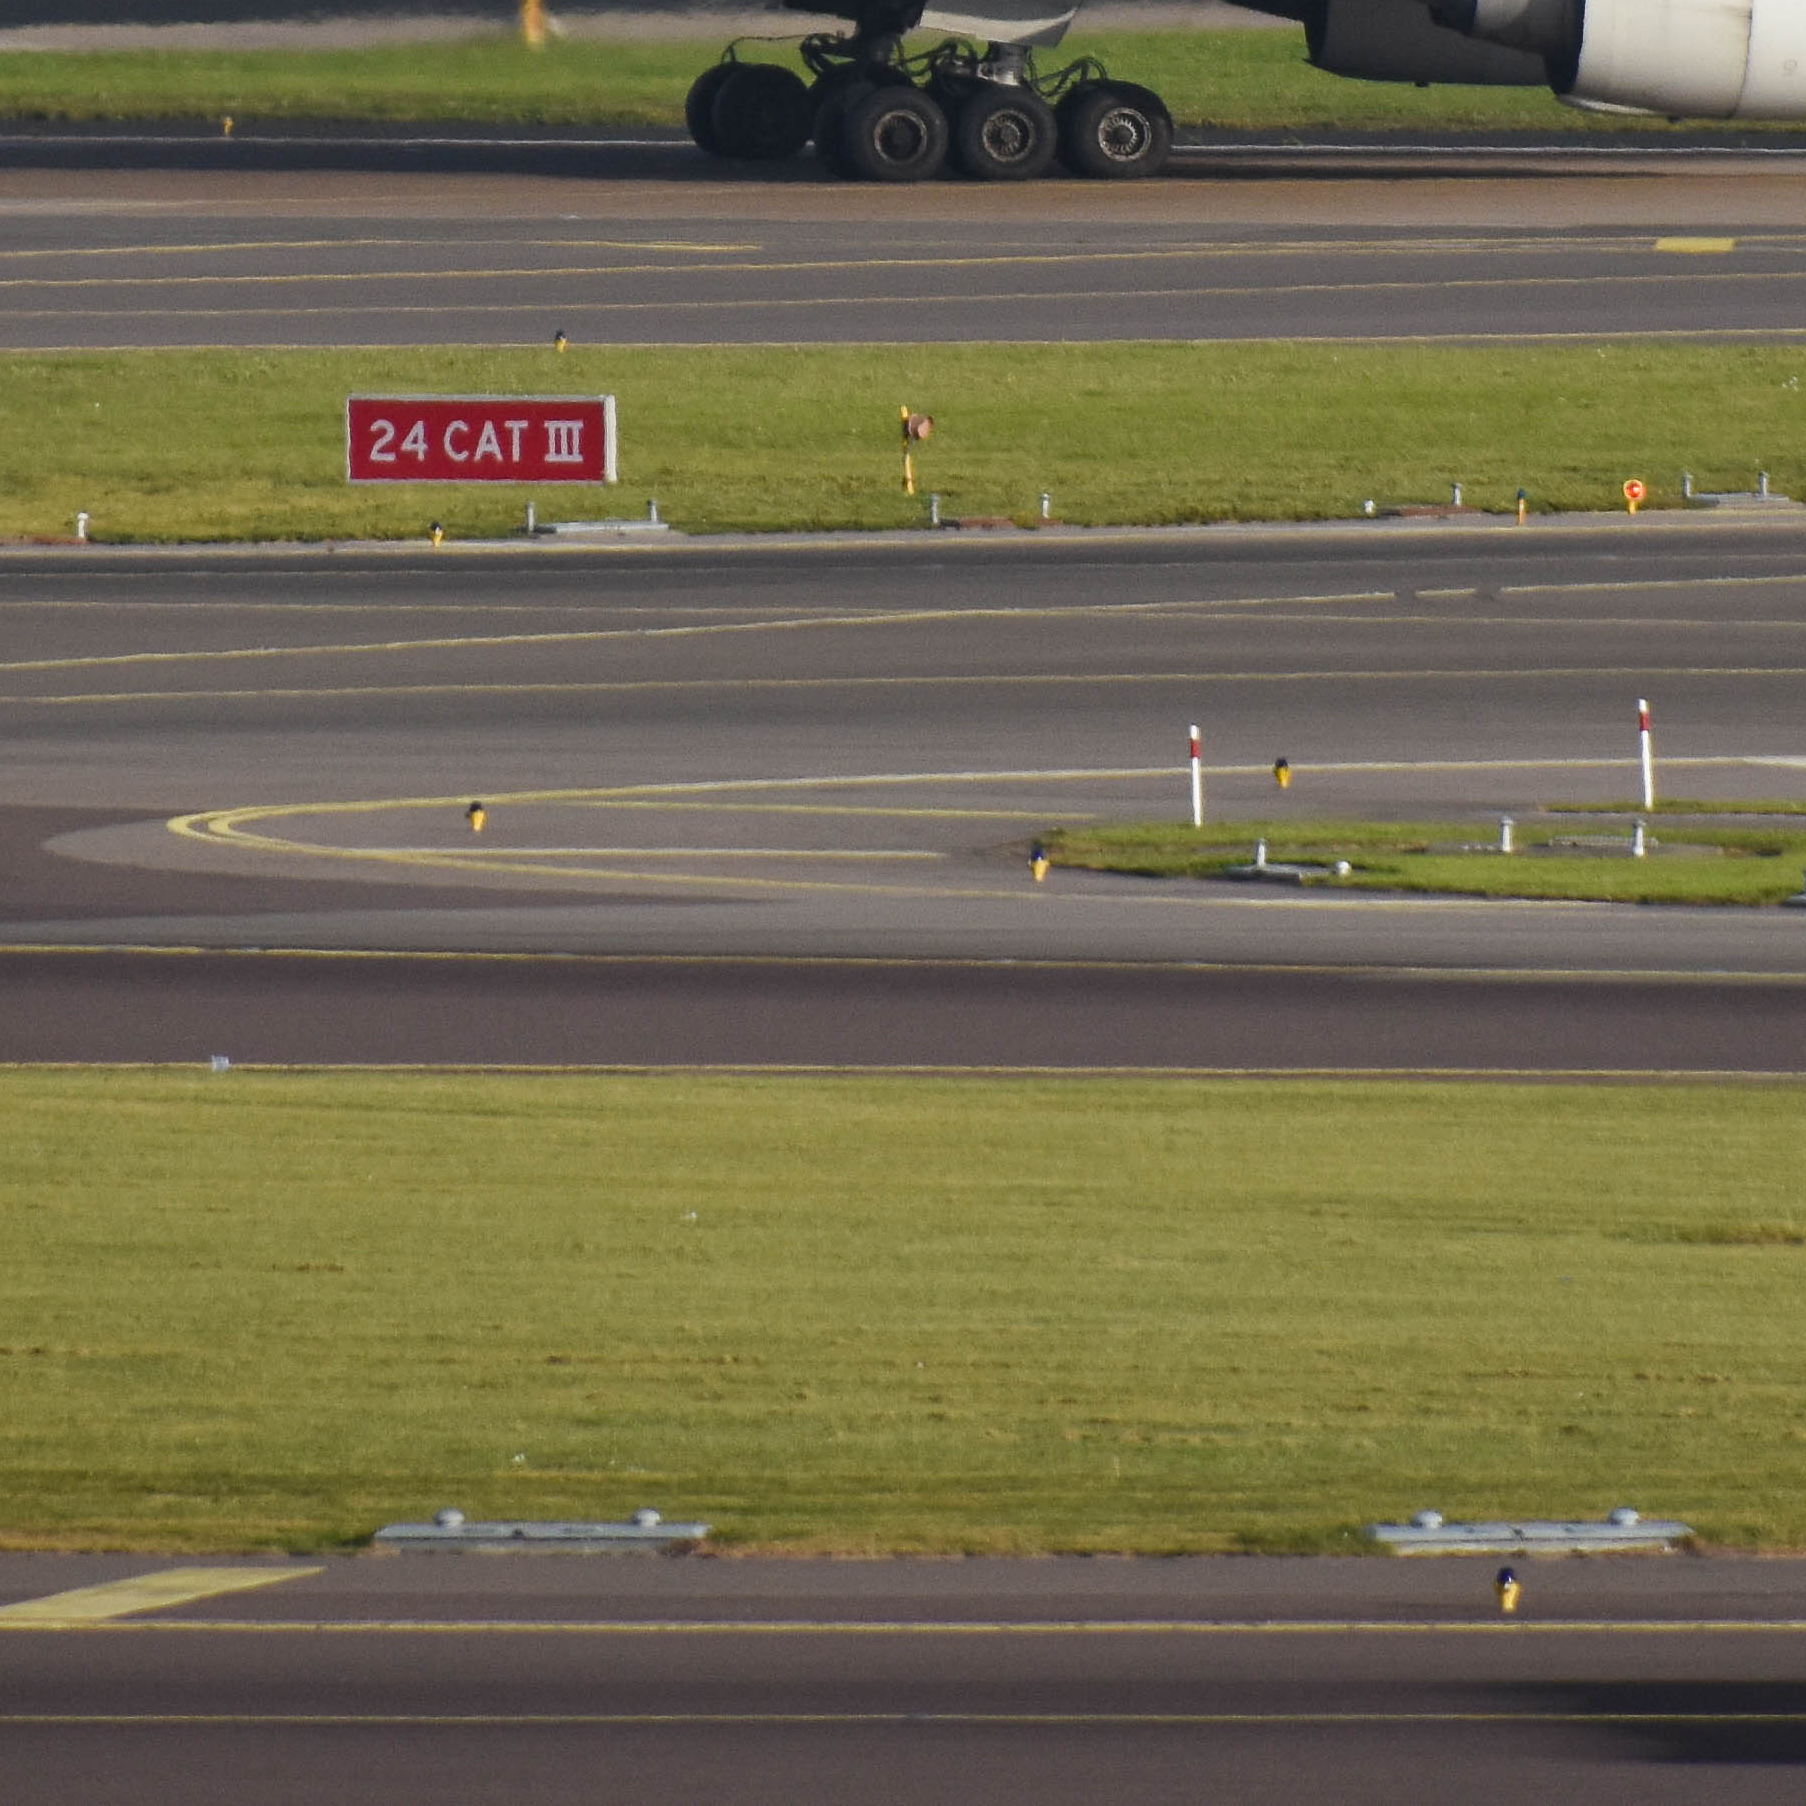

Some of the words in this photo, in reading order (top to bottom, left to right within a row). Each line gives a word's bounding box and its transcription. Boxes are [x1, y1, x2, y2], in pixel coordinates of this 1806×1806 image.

[370, 420, 429, 462] 24
[444, 420, 529, 462] CAT
[544, 420, 584, 462] III
